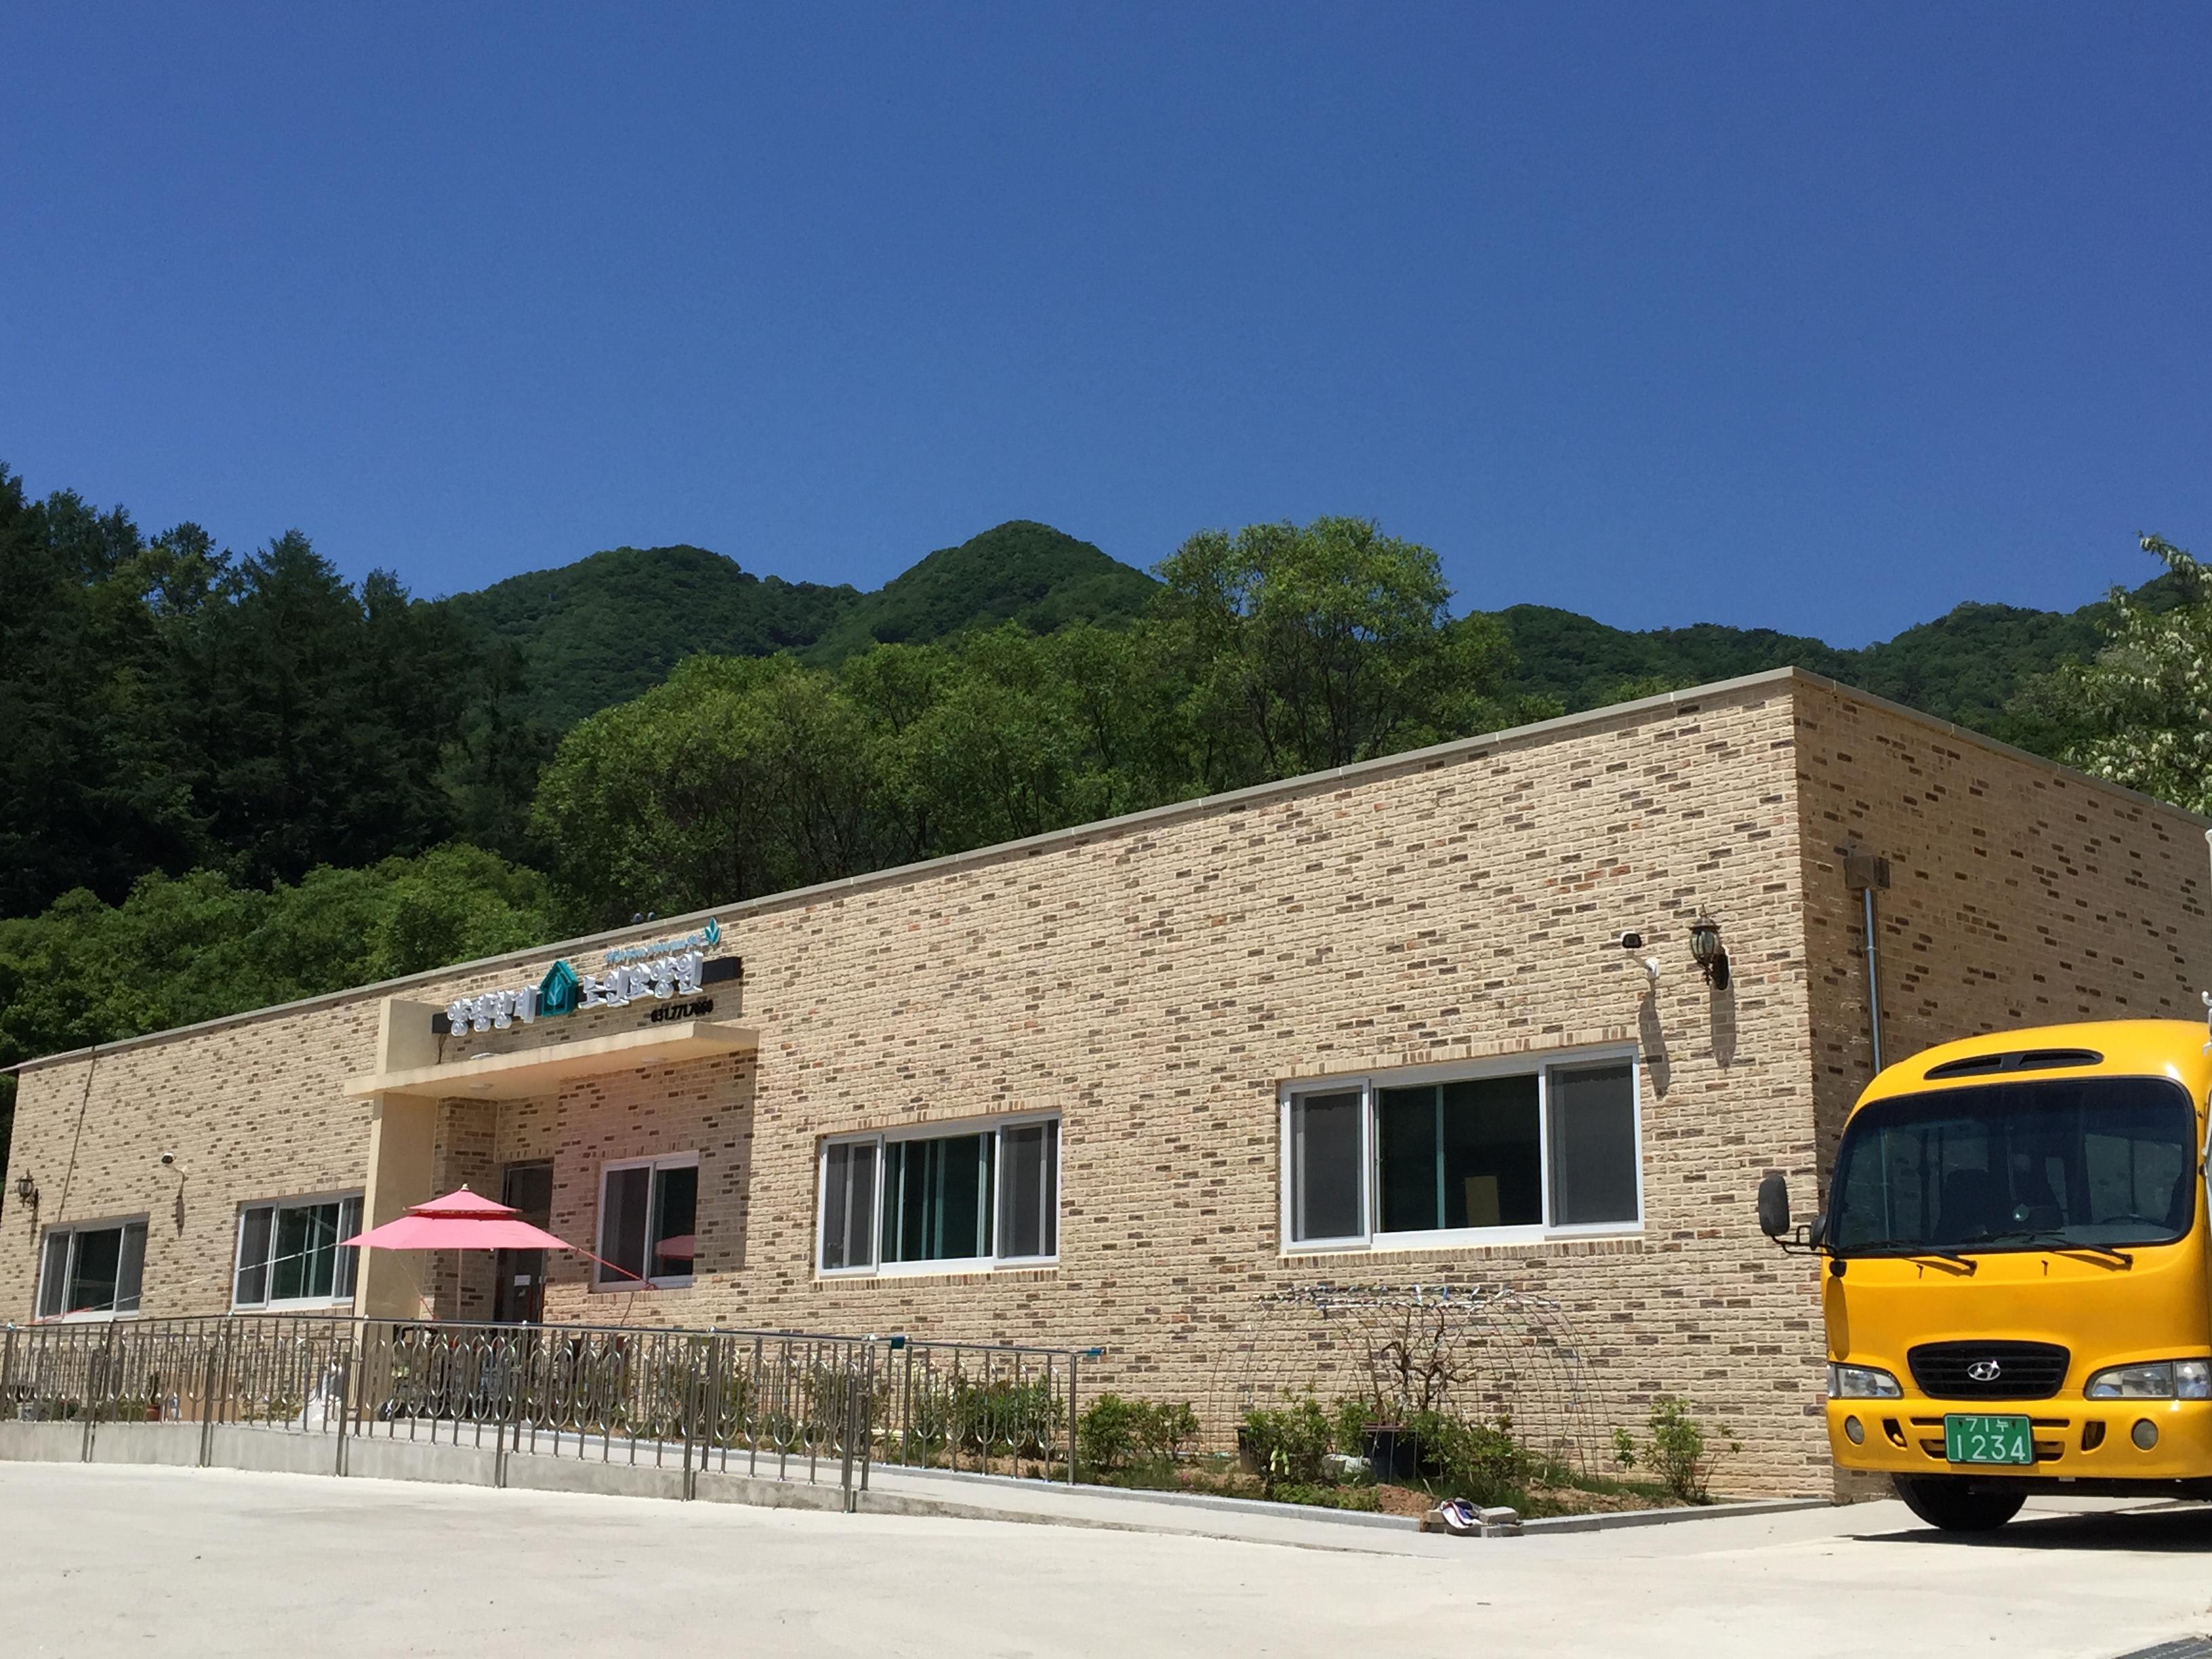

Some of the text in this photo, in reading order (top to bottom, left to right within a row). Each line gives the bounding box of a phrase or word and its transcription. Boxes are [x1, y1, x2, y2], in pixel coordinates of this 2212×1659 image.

[578, 950, 704, 1009] 노인요양원
[1965, 1417, 2009, 1433] 71누
[1957, 1434, 2026, 1460] 1234
